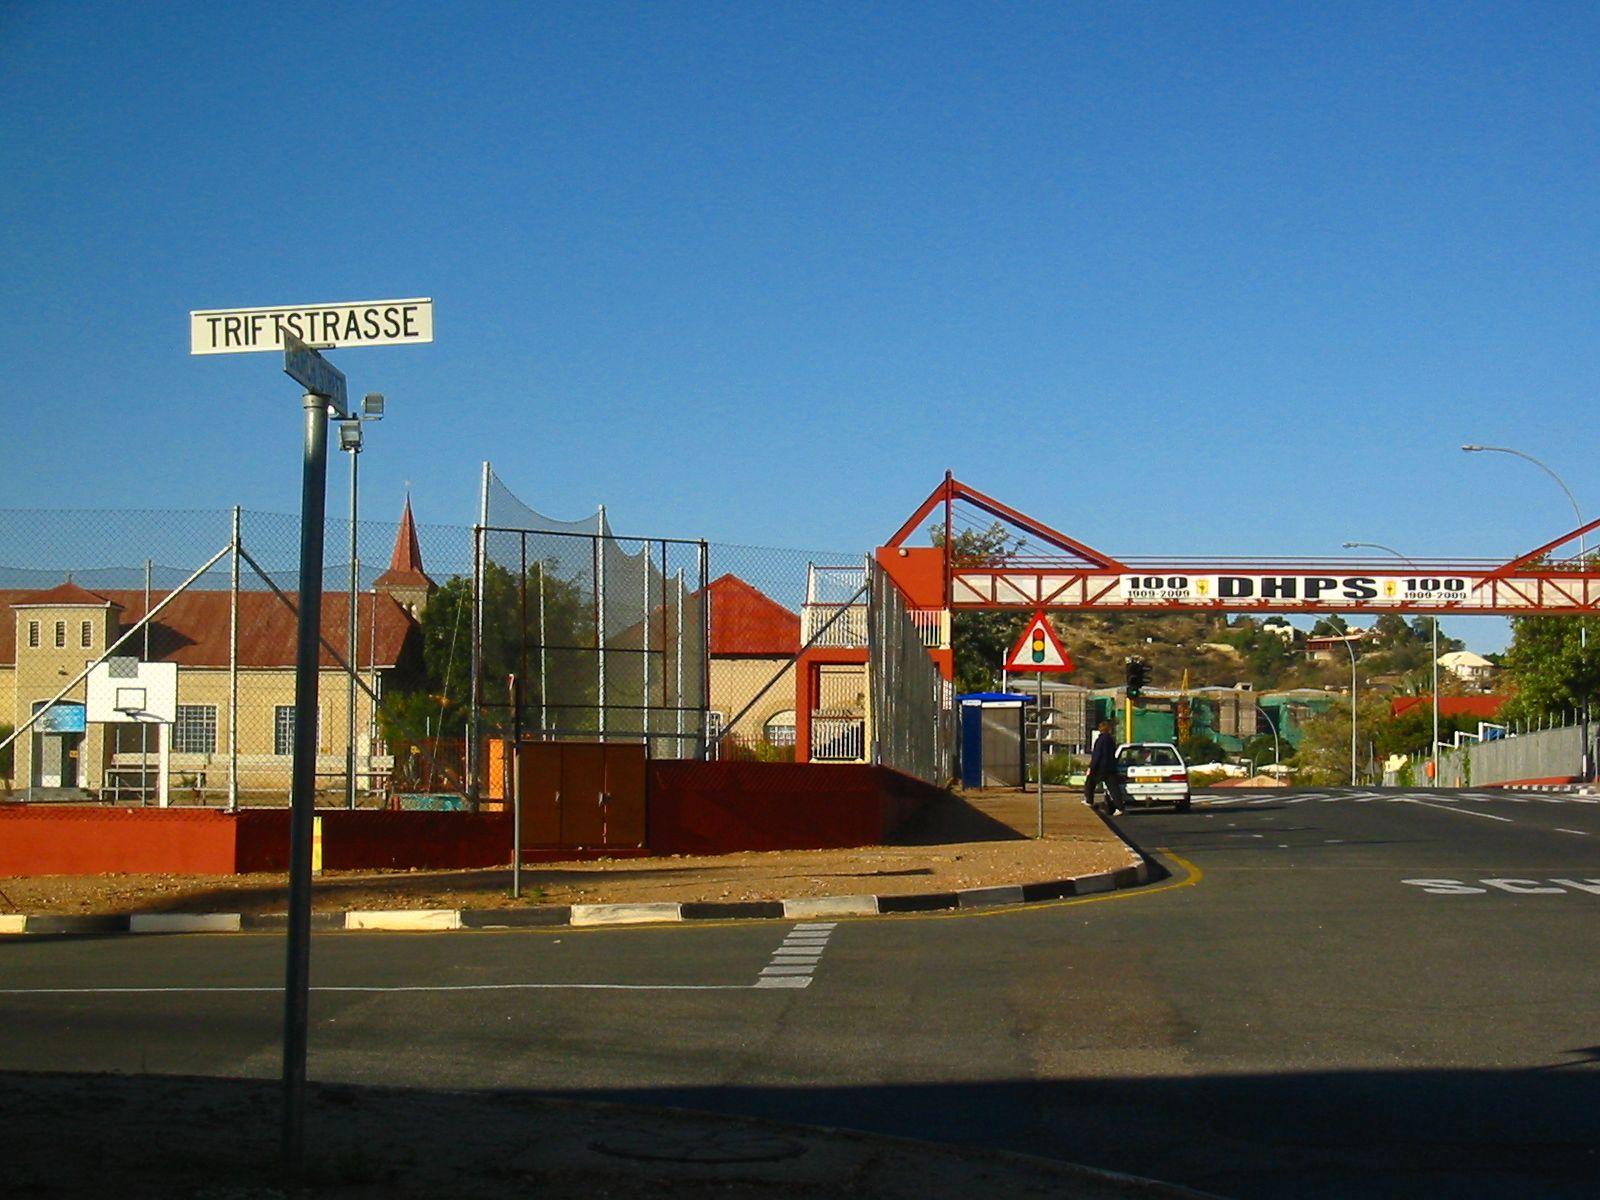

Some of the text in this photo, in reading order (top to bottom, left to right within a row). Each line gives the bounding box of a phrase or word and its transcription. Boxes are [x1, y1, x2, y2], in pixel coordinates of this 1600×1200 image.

[206, 306, 419, 348] TRIFTSTRASSE
[1126, 577, 1188, 589] 100
[1218, 577, 1378, 599] DHPS
[1402, 578, 1465, 591] 100
[1127, 590, 1190, 598] 1909-2009
[1404, 591, 1467, 599] 1909-2009
